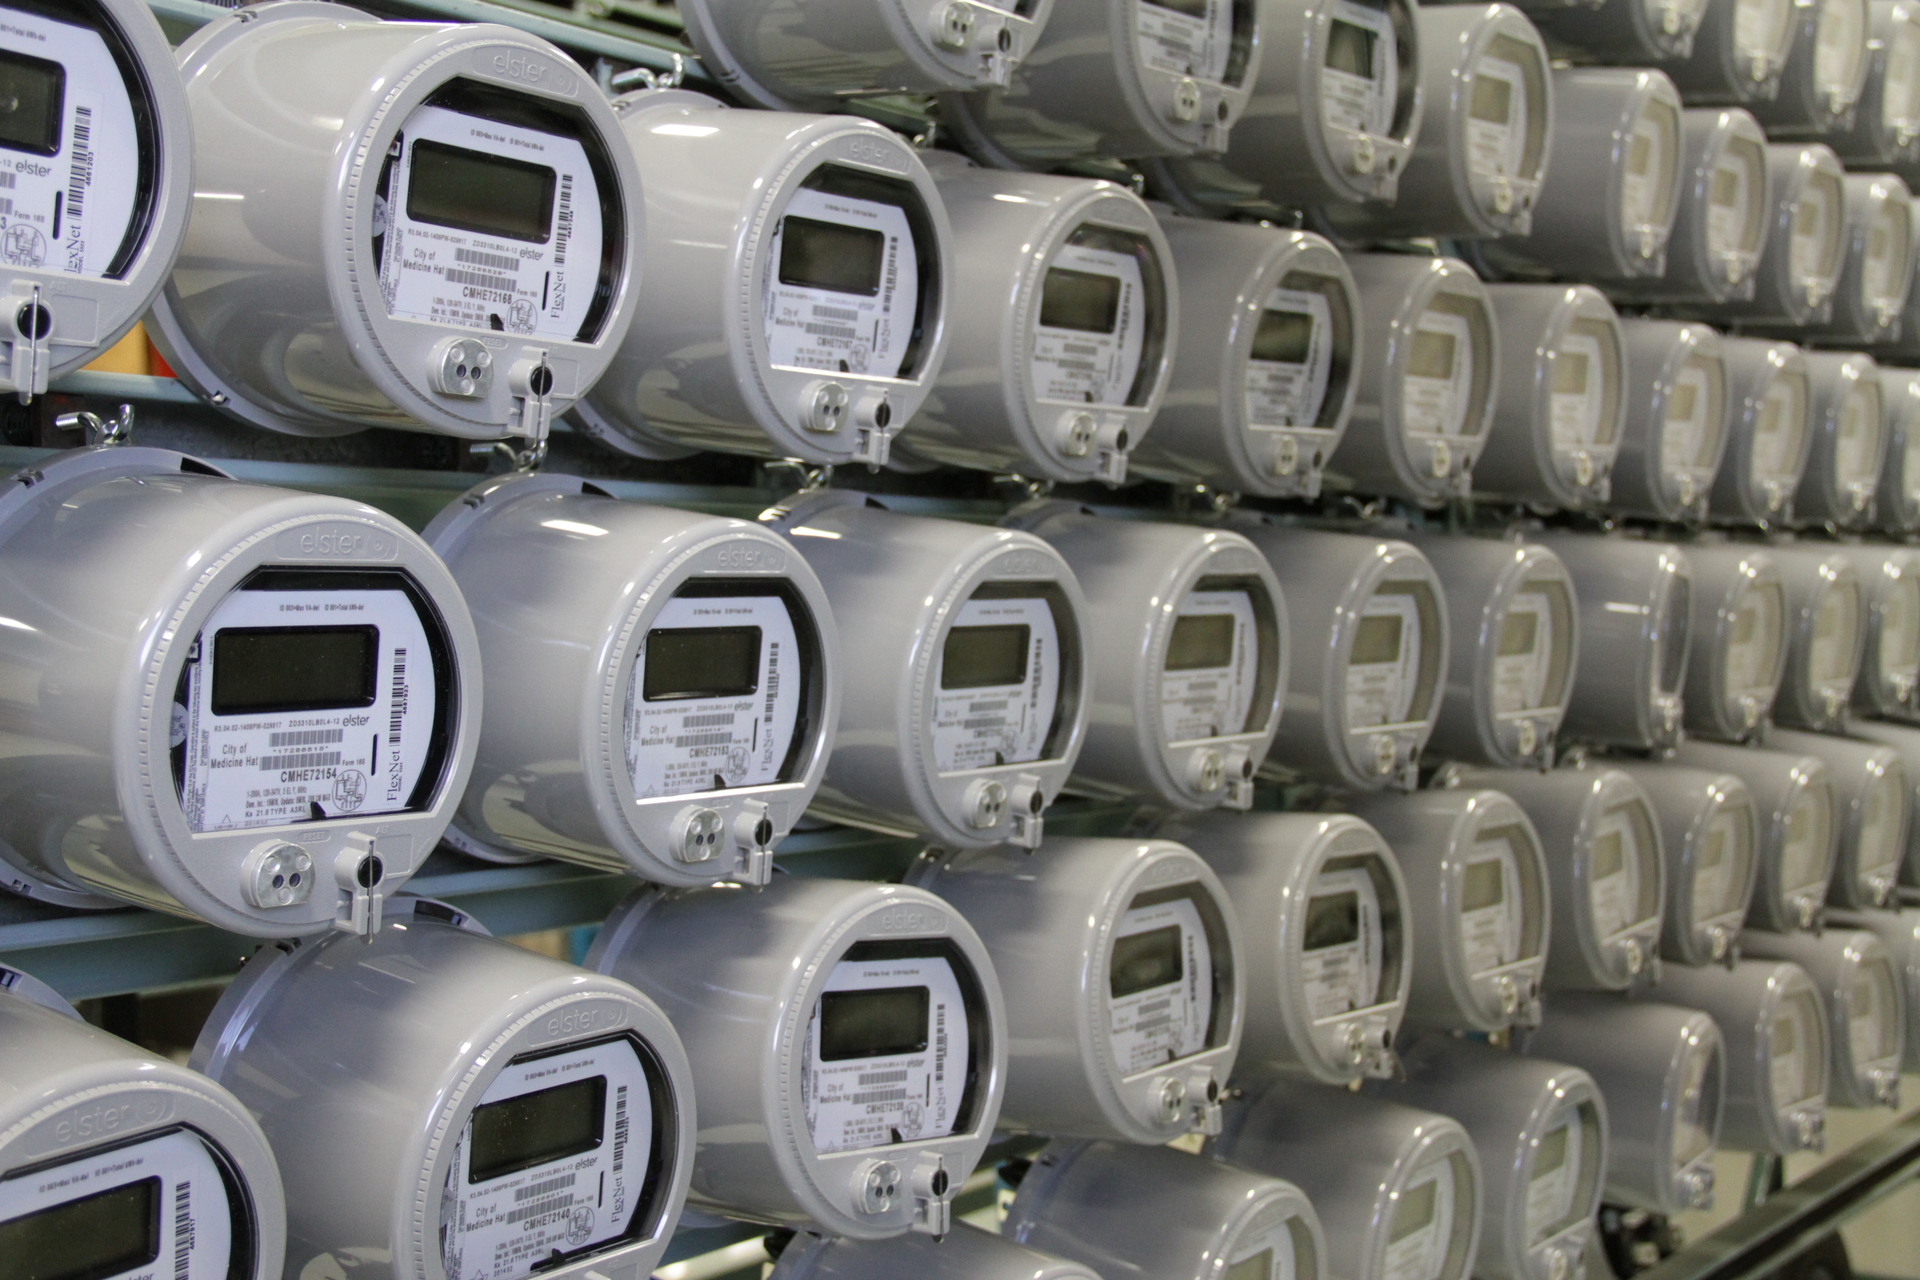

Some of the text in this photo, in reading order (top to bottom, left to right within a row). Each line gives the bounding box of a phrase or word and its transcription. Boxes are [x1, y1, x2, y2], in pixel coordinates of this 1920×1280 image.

[493, 50, 548, 83] elster
[15, 159, 51, 177] elster
[85, 151, 94, 187] 4661203
[14, 210, 31, 220] Form
[63, 225, 82, 275] lexNet
[414, 248, 436, 262] City of
[520, 246, 544, 261] elster
[402, 258, 446, 276] Medicine Hat
[462, 286, 513, 306] CMHE72168
[550, 271, 565, 319] FlexNet
[300, 526, 362, 555] elster
[718, 544, 761, 568] elster
[734, 700, 754, 712] elster
[342, 714, 370, 728] elster
[650, 724, 668, 738] City of
[222, 742, 248, 756] City of
[641, 736, 664, 746] Medicine
[210, 756, 259, 769] Medicine Hat
[280, 768, 338, 784] CMHE72154
[386, 750, 401, 802] FlexNet
[271, 807, 286, 815] TYPE
[548, 1010, 598, 1036] elster
[57, 1104, 130, 1142] elster
[575, 1156, 599, 1171] elster
[611, 1176, 623, 1224] FlexNet
[476, 1203, 497, 1220] City of
[523, 1208, 571, 1232] CMHE72140
[466, 1212, 506, 1232] Medicine Hat
